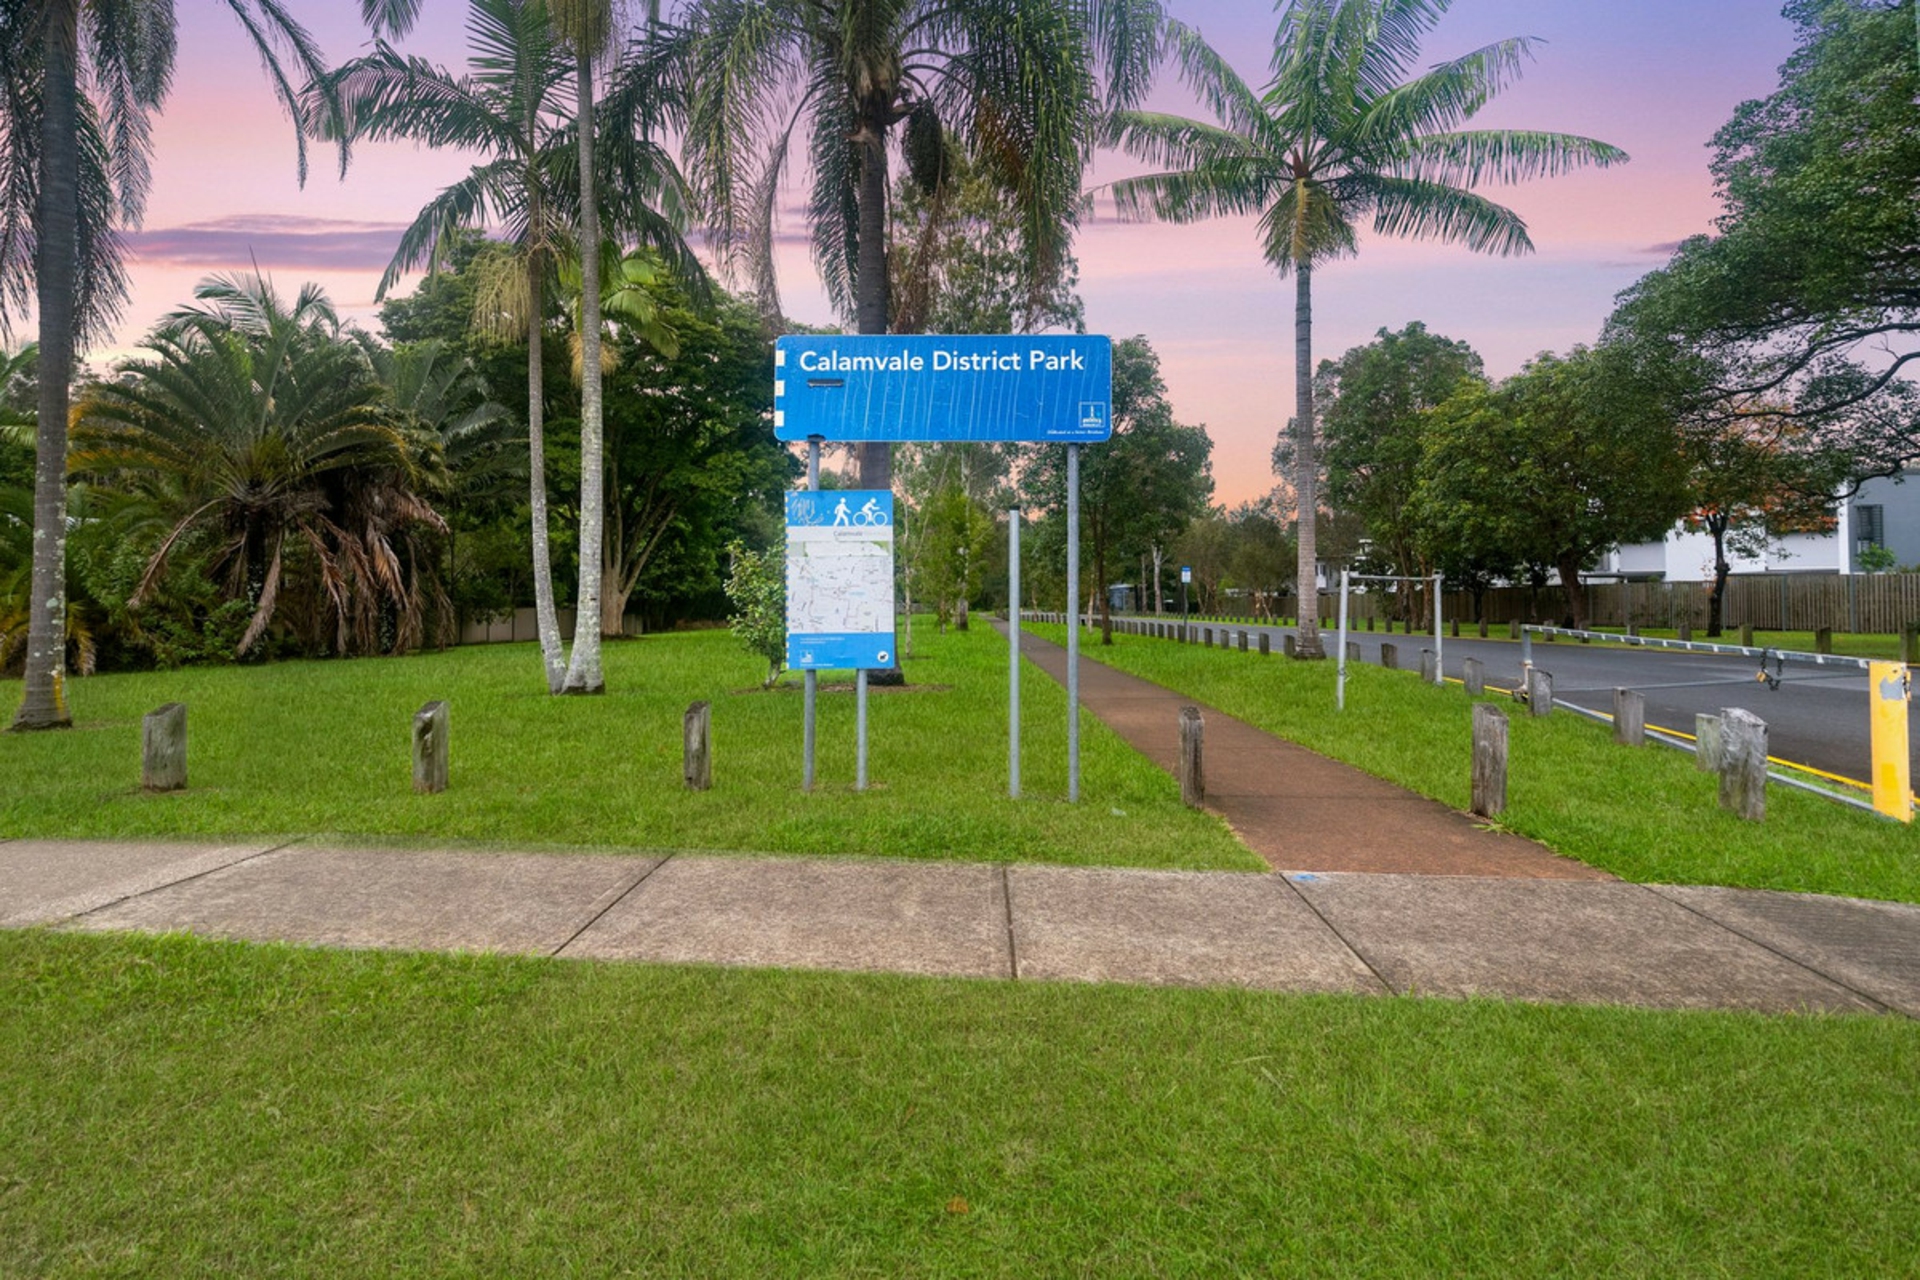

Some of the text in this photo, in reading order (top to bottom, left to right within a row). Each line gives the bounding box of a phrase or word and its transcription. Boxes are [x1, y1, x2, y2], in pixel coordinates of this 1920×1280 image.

[799, 349, 1085, 372] Calamvale District Park
